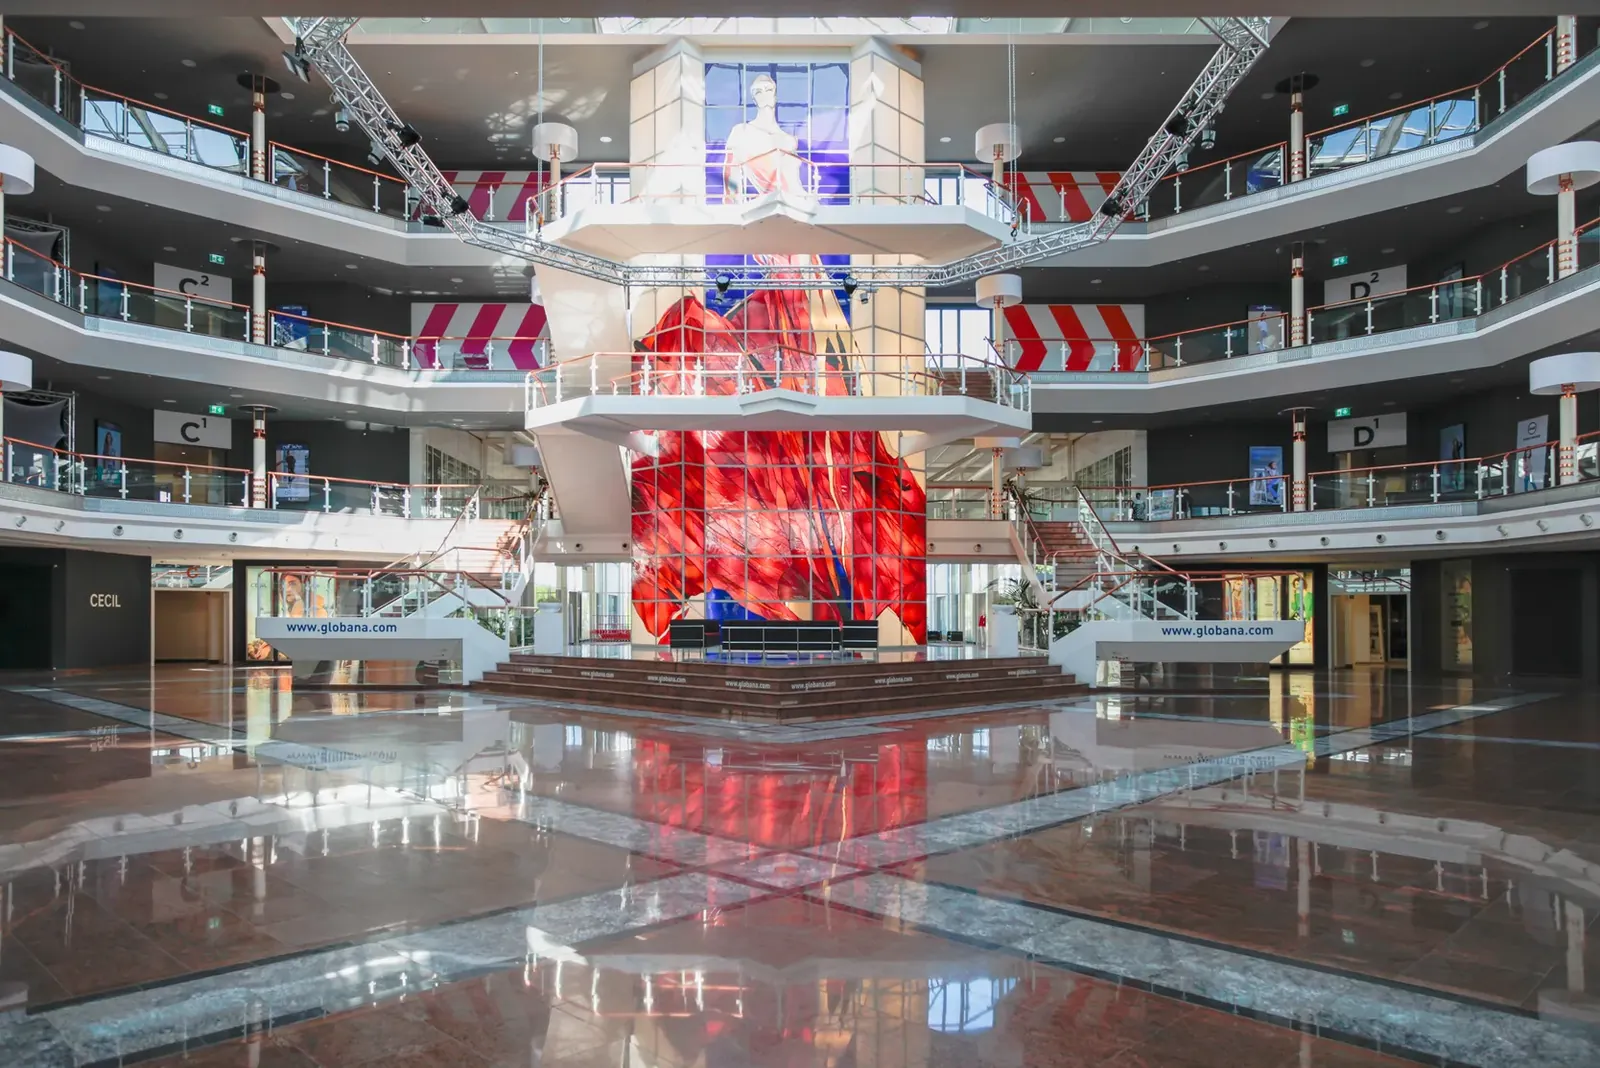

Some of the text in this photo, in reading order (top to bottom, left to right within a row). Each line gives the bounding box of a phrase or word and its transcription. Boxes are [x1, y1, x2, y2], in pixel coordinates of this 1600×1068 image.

[90, 593, 121, 608] CECIL
[286, 622, 397, 634] www.globana.com
[1162, 625, 1274, 638] www.globana.com
[647, 674, 687, 684] www.globana.com
[874, 675, 913, 686] www.globana.com
[725, 680, 771, 690] www.globana.com
[791, 681, 836, 691] www.globana.com
